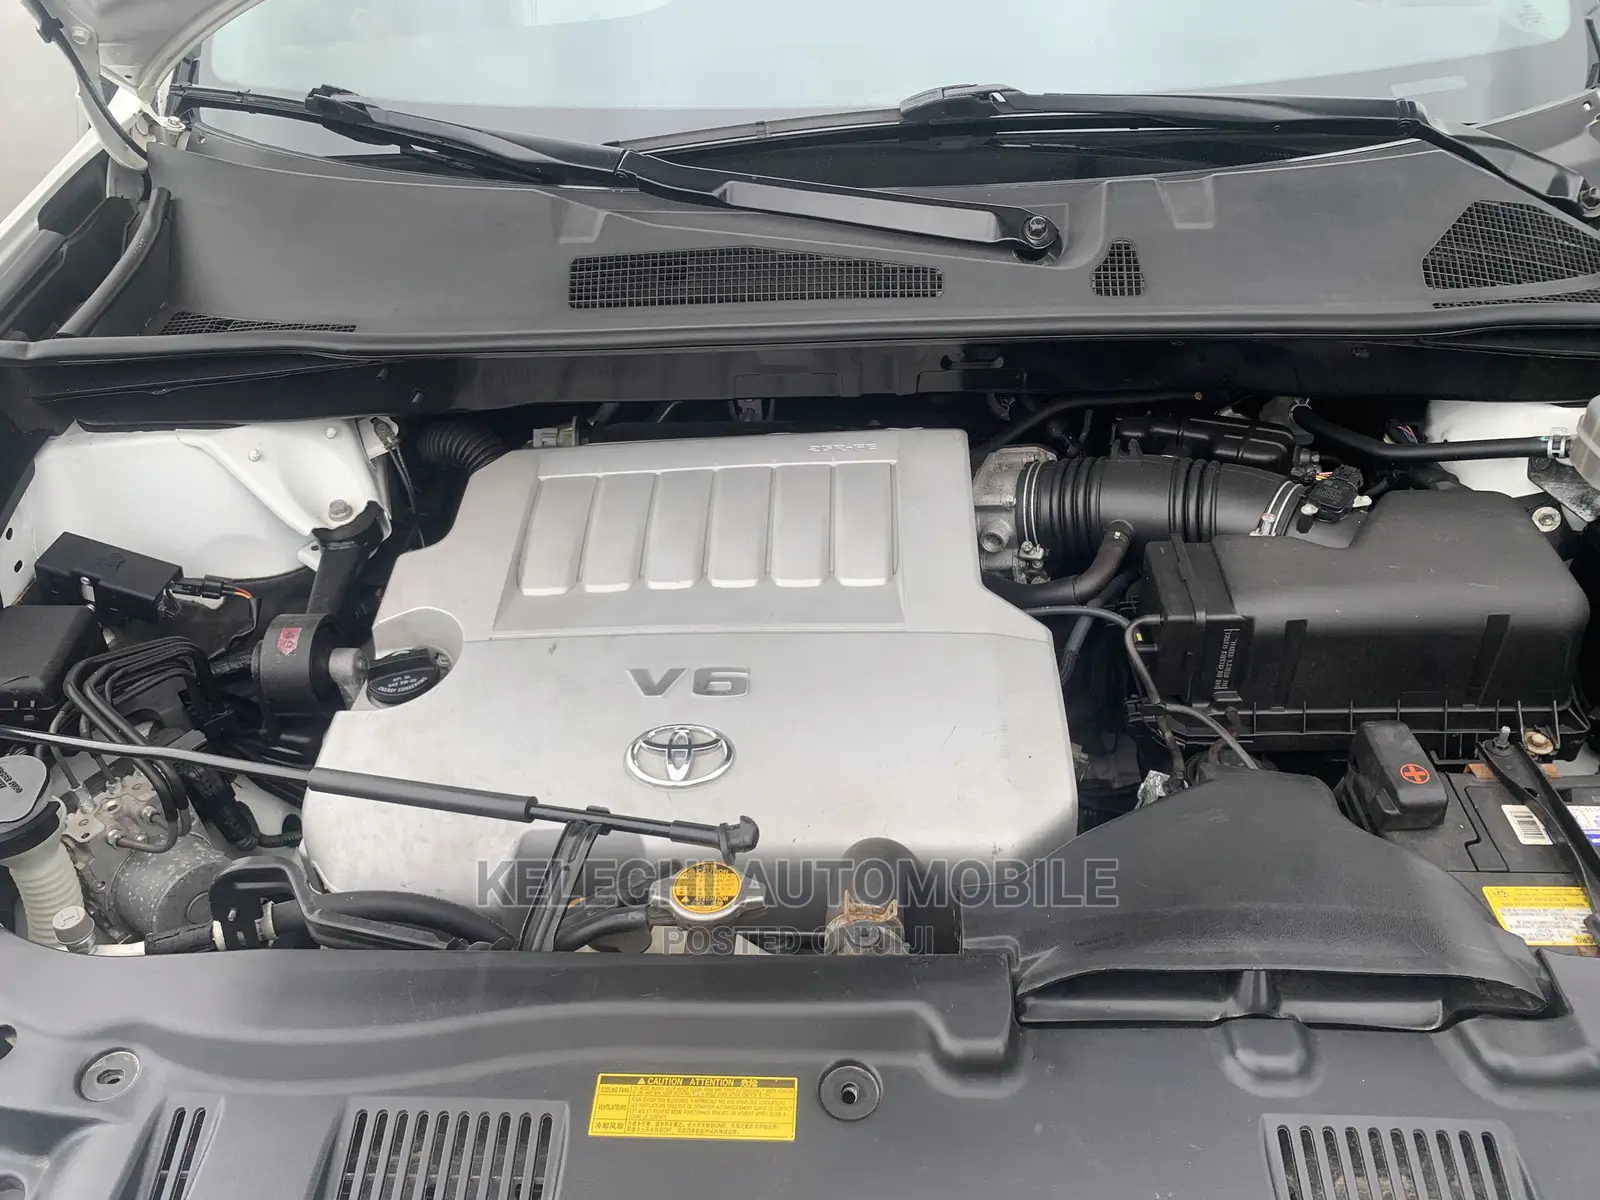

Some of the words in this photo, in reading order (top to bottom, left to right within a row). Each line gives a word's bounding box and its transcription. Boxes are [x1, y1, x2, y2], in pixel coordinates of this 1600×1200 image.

[624, 666, 749, 698] V6
[647, 1077, 683, 1086] CAUTION
[690, 1078, 735, 1087] ATTENTION
